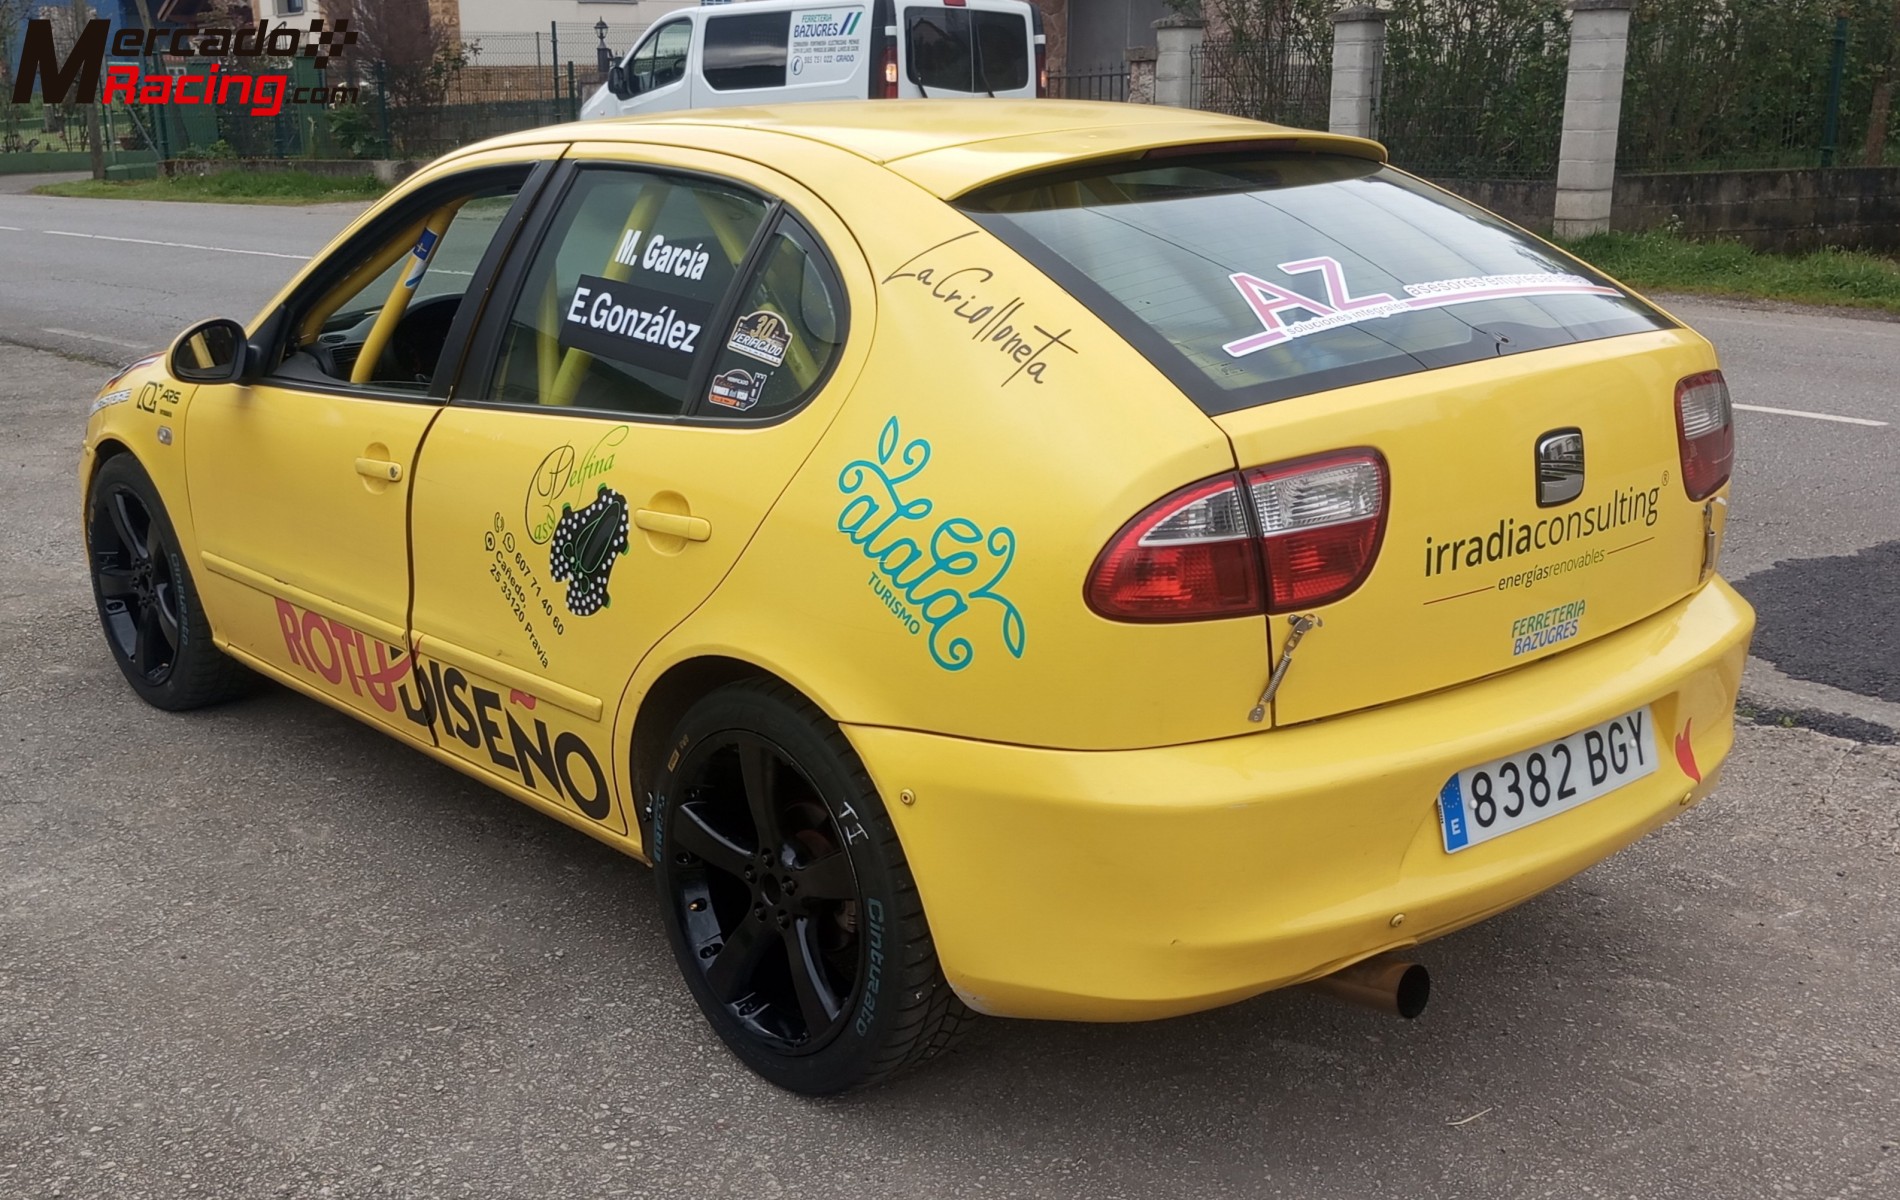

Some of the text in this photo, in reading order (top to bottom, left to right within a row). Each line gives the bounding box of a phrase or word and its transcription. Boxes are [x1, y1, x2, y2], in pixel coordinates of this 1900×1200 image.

[794, 23, 838, 38] BAZUGRES
[614, 229, 710, 281] M. García
[882, 230, 980, 285] La
[1229, 256, 1395, 332] AZ
[1407, 277, 1486, 296] asesores
[566, 287, 702, 353] E.González
[732, 331, 783, 357] VERIFICADO
[750, 315, 778, 340] 30
[1286, 301, 1410, 336] soluciones integrales
[1424, 486, 1660, 577] irradiaconsulting
[489, 563, 549, 669] 25 33120 Pravia
[515, 552, 565, 636] 607 71 40 60
[867, 571, 921, 635] TURISMO
[1511, 599, 1586, 638] FERRETERIA
[1513, 620, 1578, 657] BAZUGRES
[1471, 711, 1645, 828] 8382 BGY
[1450, 818, 1461, 835] E
[856, 897, 886, 1037] Cinturato
